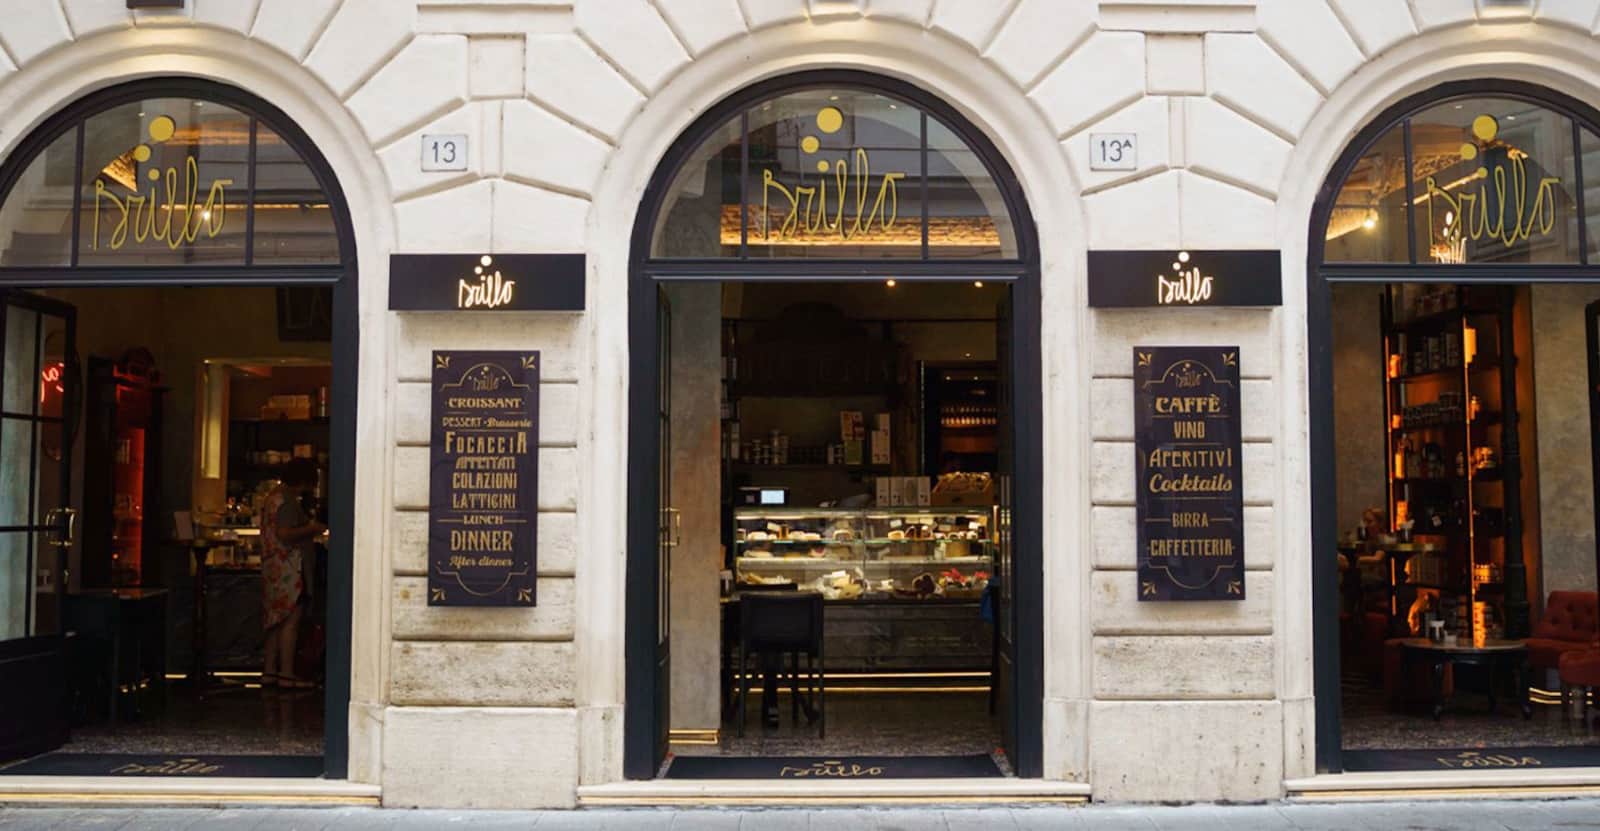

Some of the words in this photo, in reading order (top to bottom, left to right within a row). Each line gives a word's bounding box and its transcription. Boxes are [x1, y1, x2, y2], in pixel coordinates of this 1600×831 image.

[431, 140, 457, 164] 13
[1100, 139, 1133, 163] 13A
[448, 397, 522, 409] CROISSANT
[1155, 393, 1221, 413] CAFFÈ
[442, 416, 482, 428] DESSERT
[1174, 421, 1206, 439] VINO
[445, 431, 528, 454] FOCACCIA
[1149, 447, 1233, 468] APERITIVI
[452, 472, 518, 489] COLAZIONI
[1149, 472, 1233, 493] Cocktails
[452, 492, 516, 509] LATTICINI
[463, 514, 504, 525] LUNCH
[1172, 511, 1210, 528] BIRRA
[450, 530, 513, 552] DINNER
[1150, 538, 1233, 556] CAFFETTERIA
[450, 555, 476, 569] After
[478, 555, 513, 567] dinner
